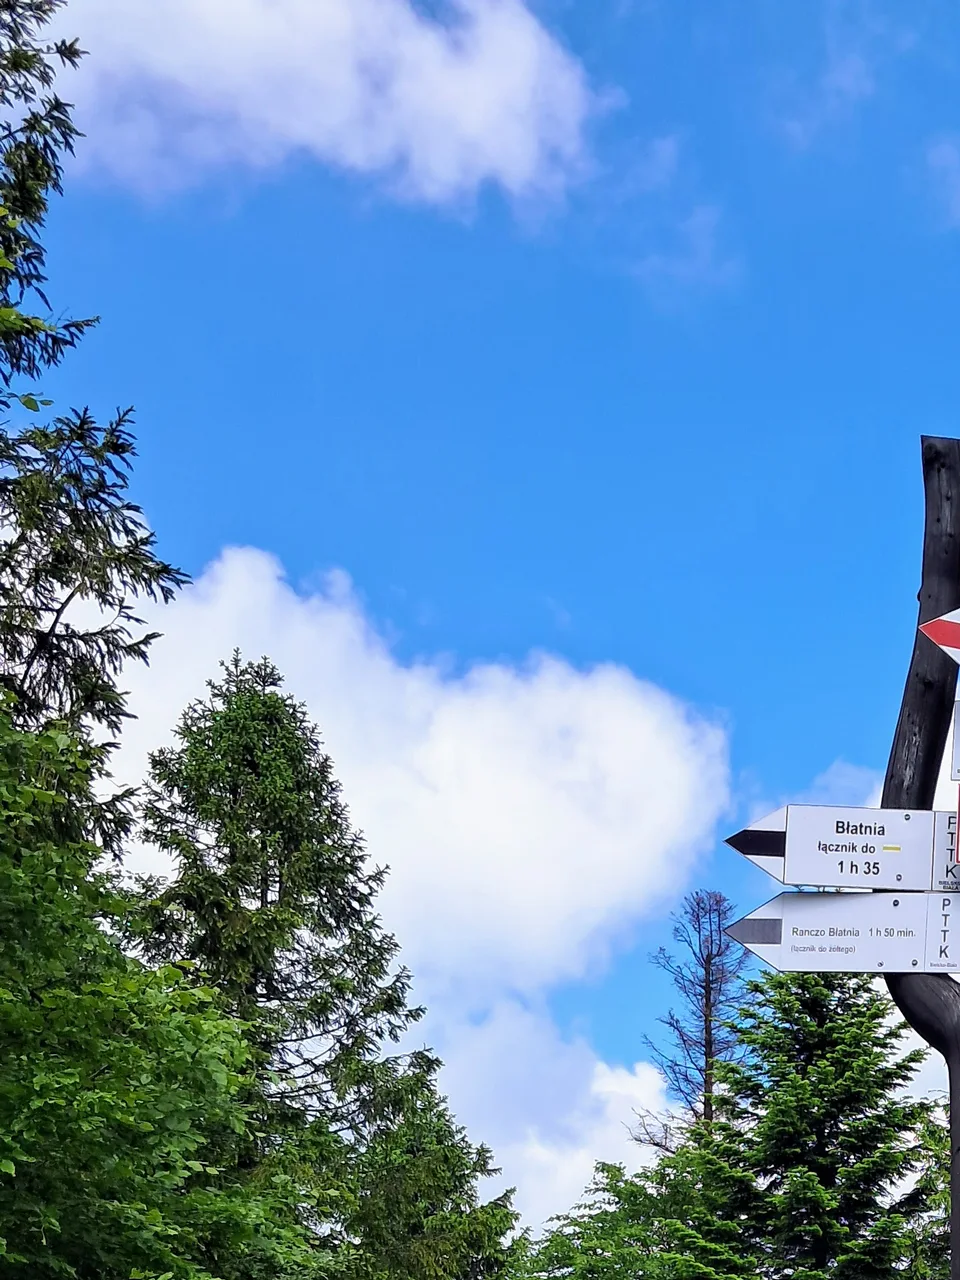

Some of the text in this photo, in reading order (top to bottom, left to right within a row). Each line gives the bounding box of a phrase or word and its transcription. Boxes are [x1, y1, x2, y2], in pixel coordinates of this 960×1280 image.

[835, 820, 886, 836] Błatnia
[817, 841, 876, 855] łącznik do
[837, 861, 880, 876] 1 h 35
[791, 927, 826, 937] Ranczo
[868, 927, 873, 937] 1
[876, 927, 882, 937] h
[883, 927, 895, 938] 50
[896, 927, 917, 938] min.
[939, 898, 951, 959] PTTK
[818, 945, 828, 953] do
